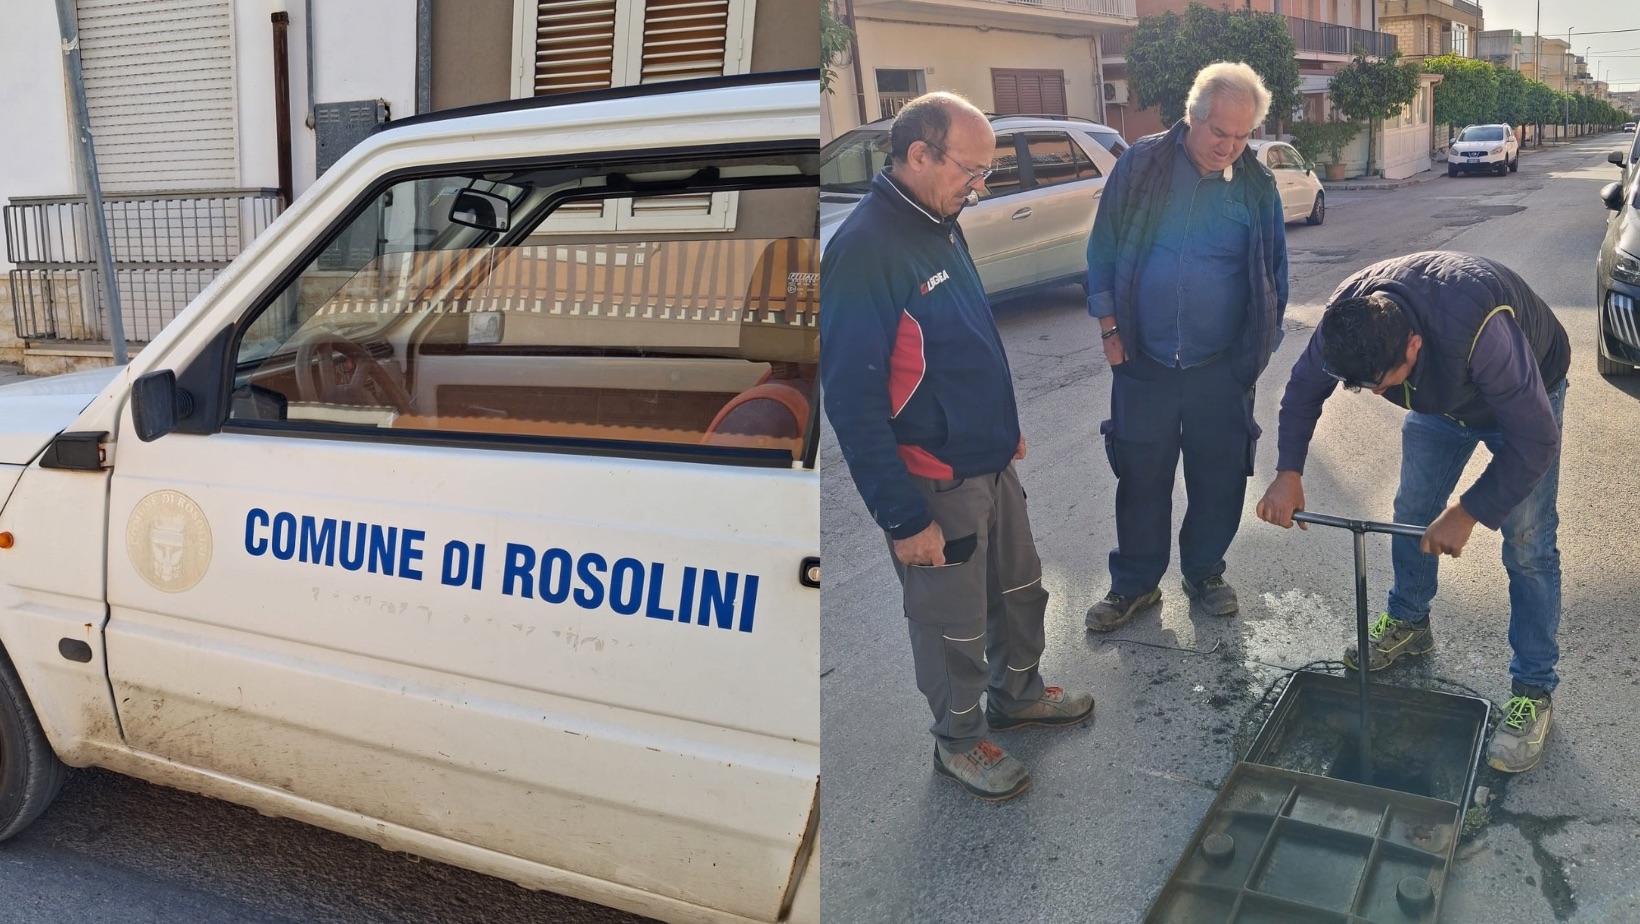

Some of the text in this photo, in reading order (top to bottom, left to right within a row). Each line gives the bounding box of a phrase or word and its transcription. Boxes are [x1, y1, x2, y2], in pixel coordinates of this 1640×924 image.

[926, 269, 950, 292] LEGEA
[162, 493, 175, 504] DI
[245, 508, 425, 580] COMUNE
[442, 540, 485, 590] DI
[503, 543, 758, 632] ROSOLINI
